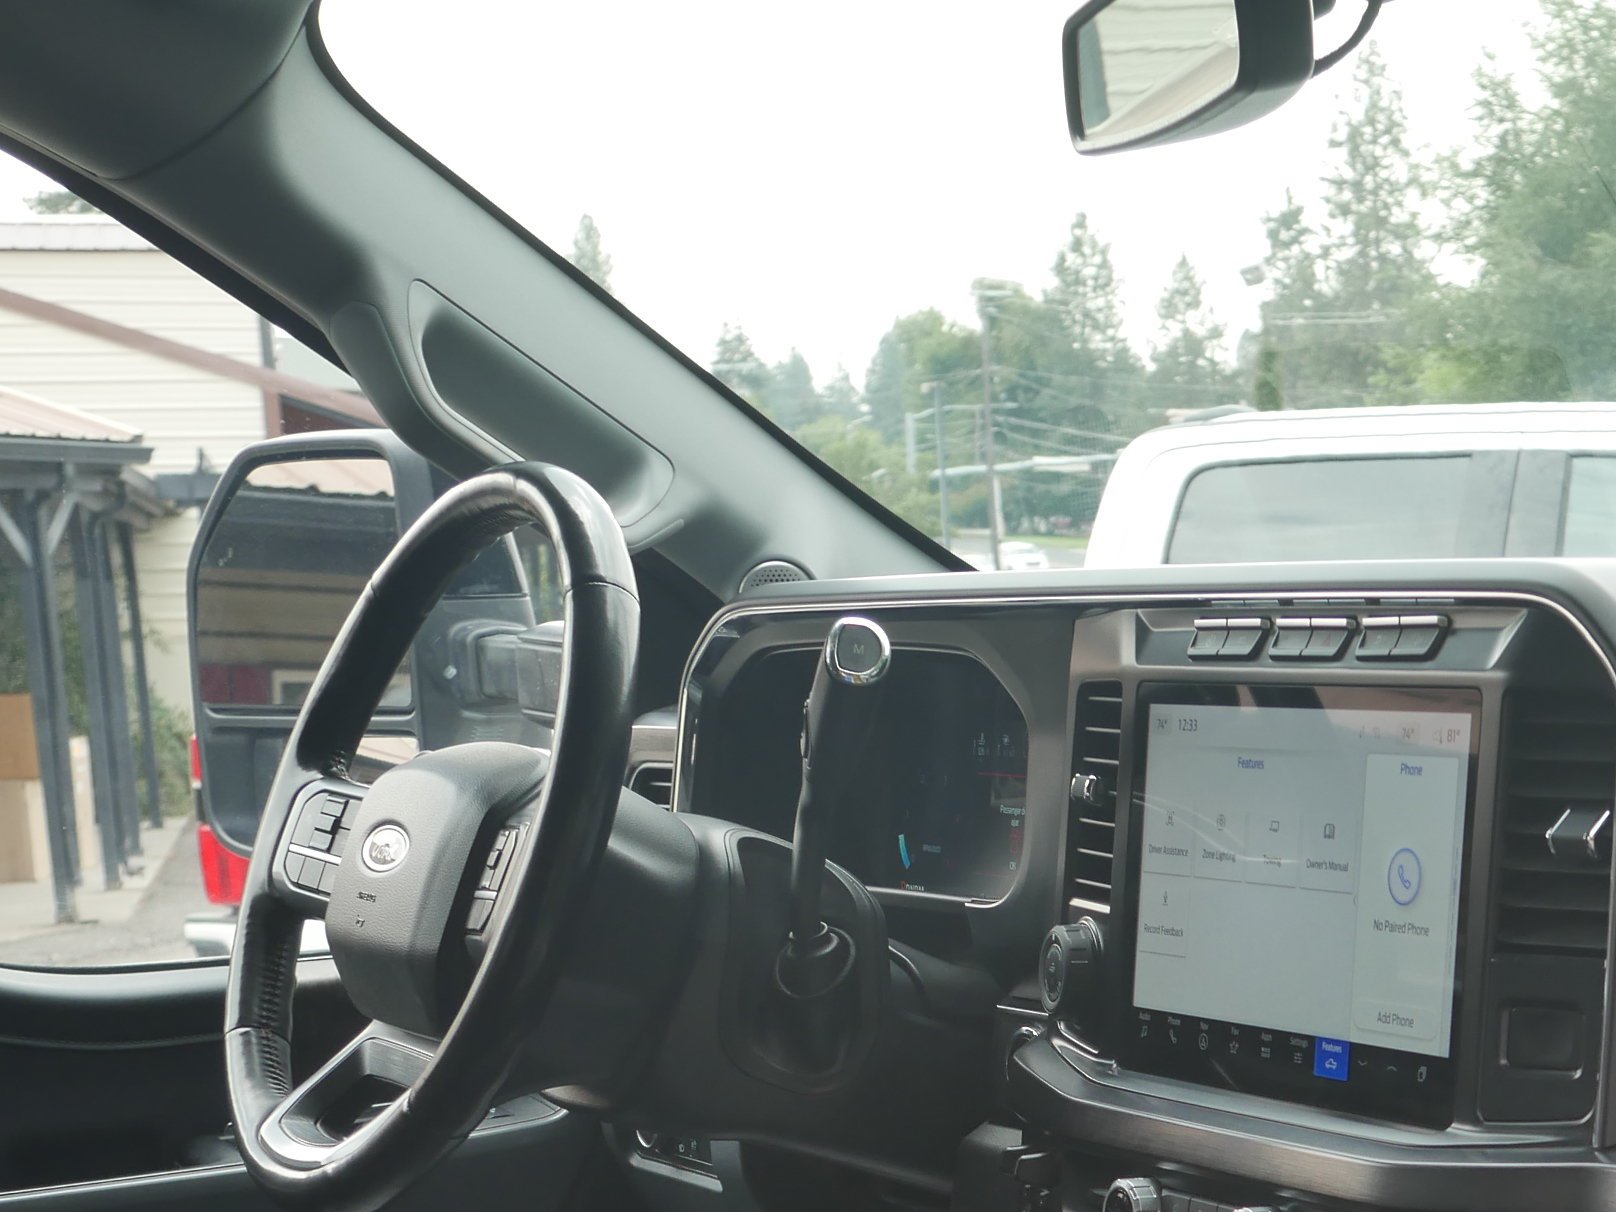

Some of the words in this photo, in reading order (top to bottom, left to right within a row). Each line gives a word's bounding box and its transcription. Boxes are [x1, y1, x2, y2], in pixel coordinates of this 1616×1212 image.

[1177, 718, 1198, 733] 12:33
[1237, 756, 1265, 771] Features
[1400, 763, 1423, 777] Phone
[1202, 849, 1214, 861] Zone
[1305, 858, 1328, 870] Owner's
[1328, 861, 1349, 873] Manual
[1143, 923, 1160, 936] Record
[1160, 926, 1184, 939] Feedback
[1373, 919, 1383, 932] No
[1384, 920, 1406, 935] Paired
[1407, 922, 1430, 937] Phone
[1377, 1011, 1391, 1025] Add
[1391, 1013, 1415, 1028] Phone
[1321, 1041, 1343, 1054] Features
